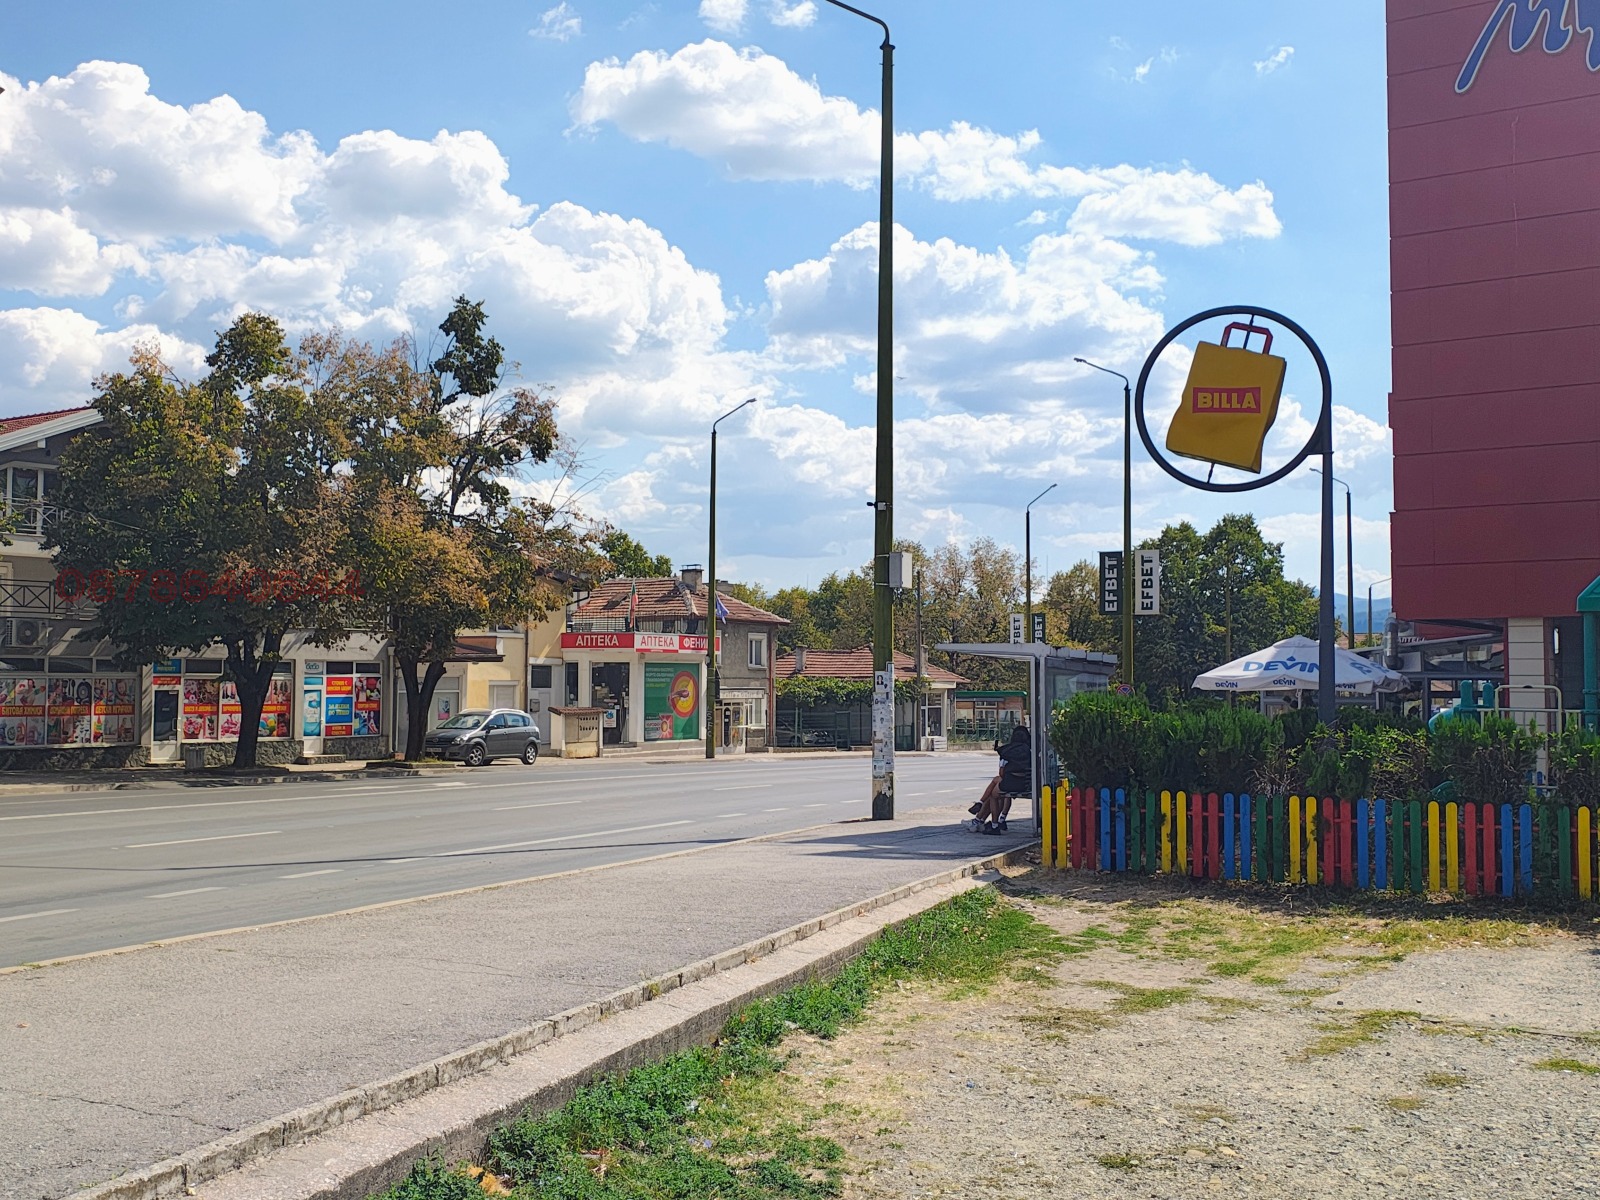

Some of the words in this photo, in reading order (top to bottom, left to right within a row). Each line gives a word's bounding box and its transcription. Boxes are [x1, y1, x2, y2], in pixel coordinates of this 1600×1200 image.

[1198, 392, 1256, 409] BILLA
[1104, 555, 1117, 612] EFBET
[1141, 554, 1153, 611] EFBET
[1013, 617, 1021, 644] FBET
[1034, 616, 1043, 643] FBET
[576, 635, 619, 647] АПТЕКА
[640, 636, 675, 648] АПТЕКА
[683, 637, 708, 649] ФЕНИ
[1215, 681, 1239, 689] DEVIN
[1273, 677, 1296, 687] DEVIN
